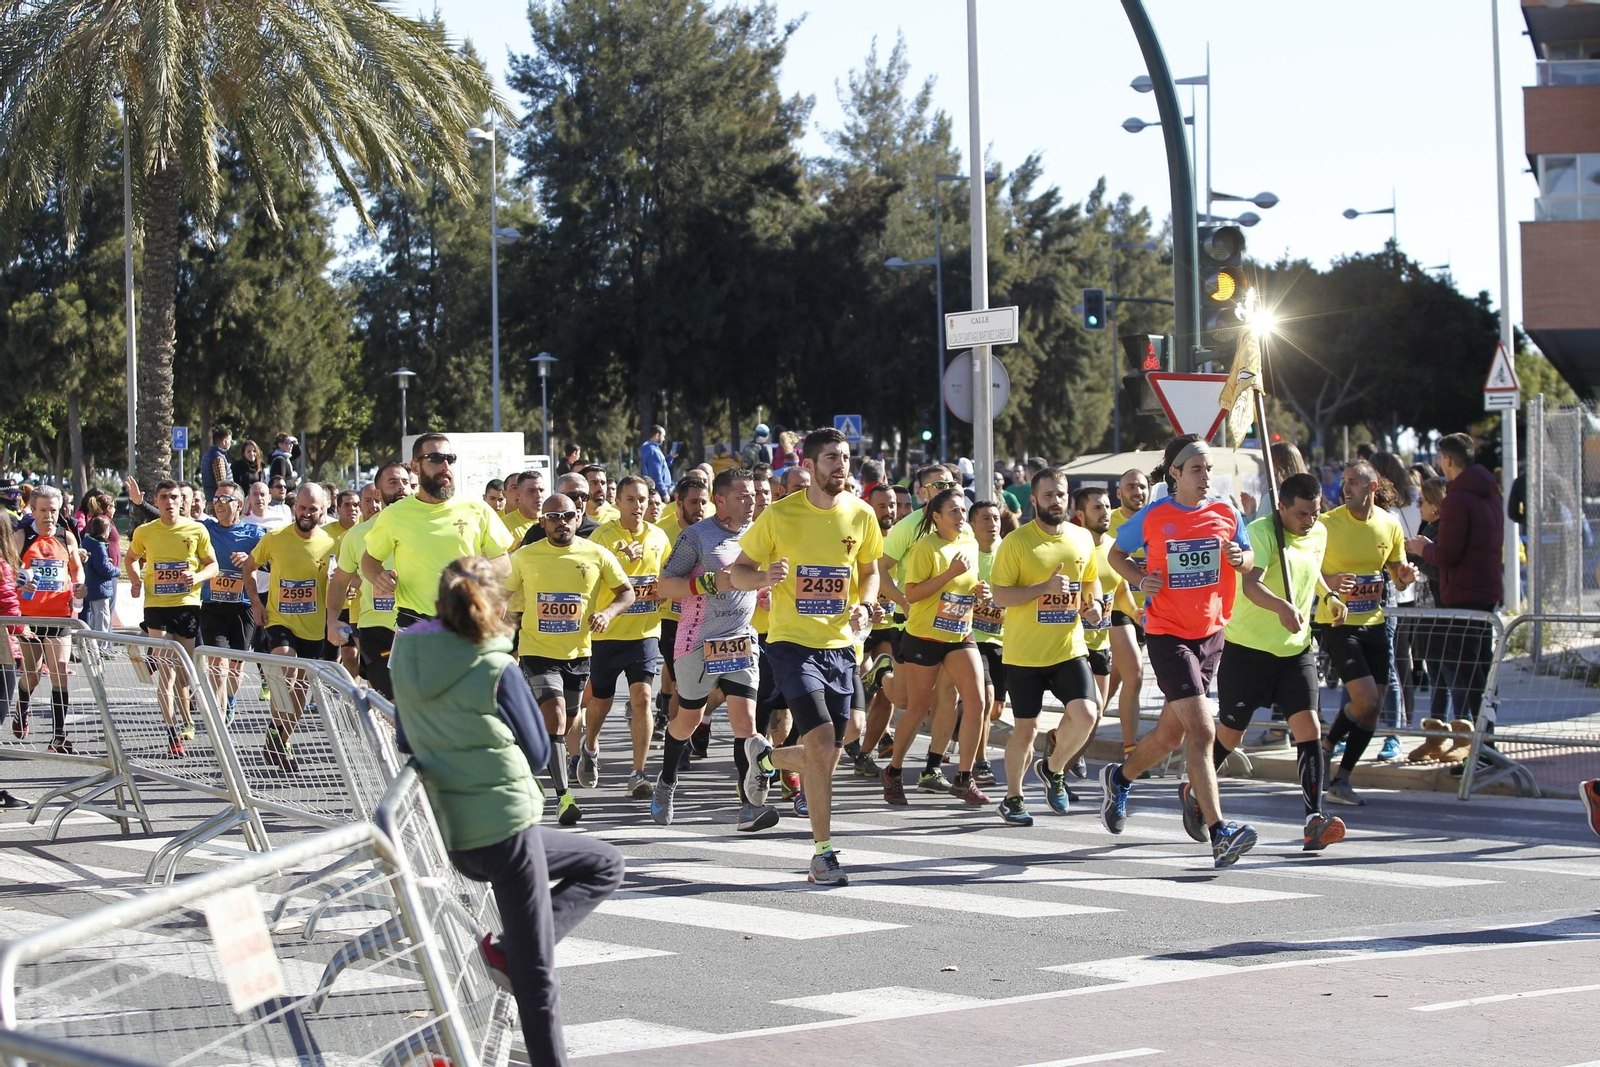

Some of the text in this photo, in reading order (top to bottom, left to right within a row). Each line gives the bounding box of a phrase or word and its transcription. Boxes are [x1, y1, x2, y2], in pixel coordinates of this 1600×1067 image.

[971, 316, 990, 325] CALLE
[176, 430, 183, 439] P
[1179, 551, 1211, 567] 996
[216, 578, 237, 588] 407
[802, 578, 844, 593] 2439
[283, 588, 312, 599] 2595
[1043, 593, 1077, 605] 2687
[541, 603, 578, 615] 2600
[973, 604, 1002, 619] 2446
[711, 640, 747, 655] 1430
